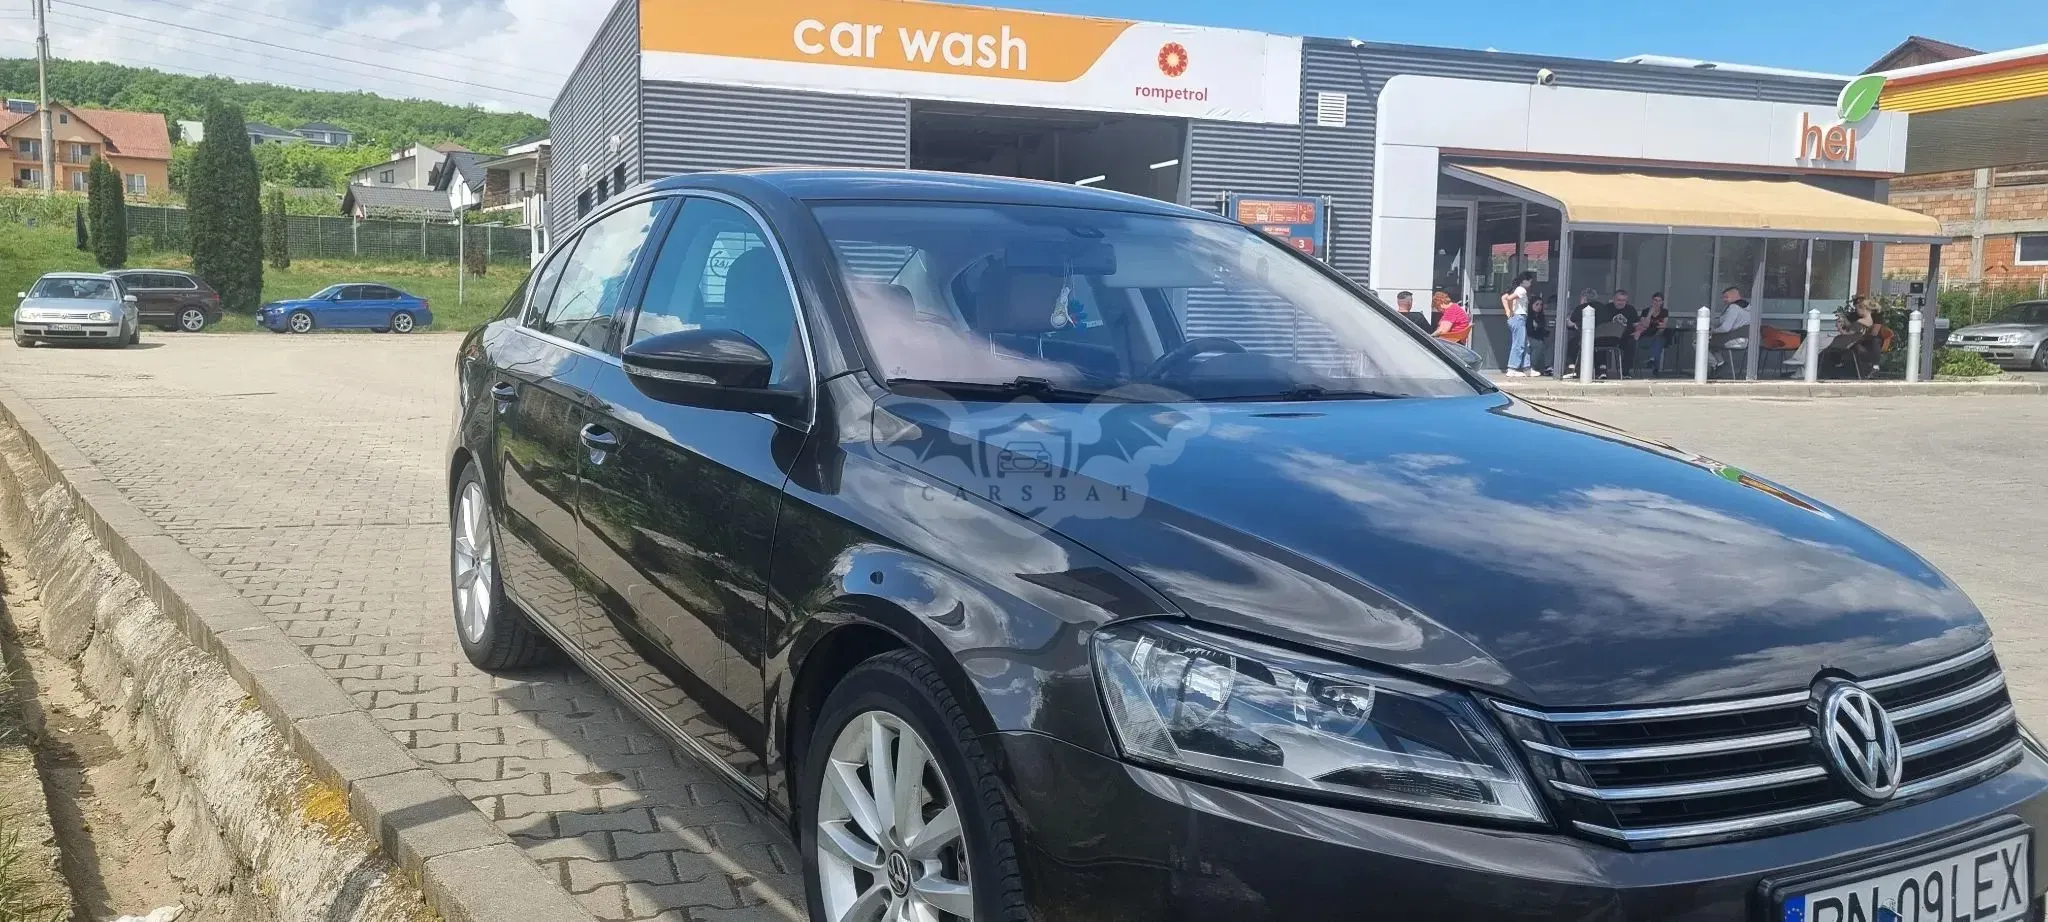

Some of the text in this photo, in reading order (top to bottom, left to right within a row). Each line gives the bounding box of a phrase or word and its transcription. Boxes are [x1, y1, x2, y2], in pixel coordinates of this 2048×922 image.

[793, 18, 1028, 71] car wash
[1134, 84, 1208, 103] rompetrol
[1799, 111, 1857, 161] hei
[1298, 239, 1305, 249] 3
[1951, 843, 2022, 922] LEX
